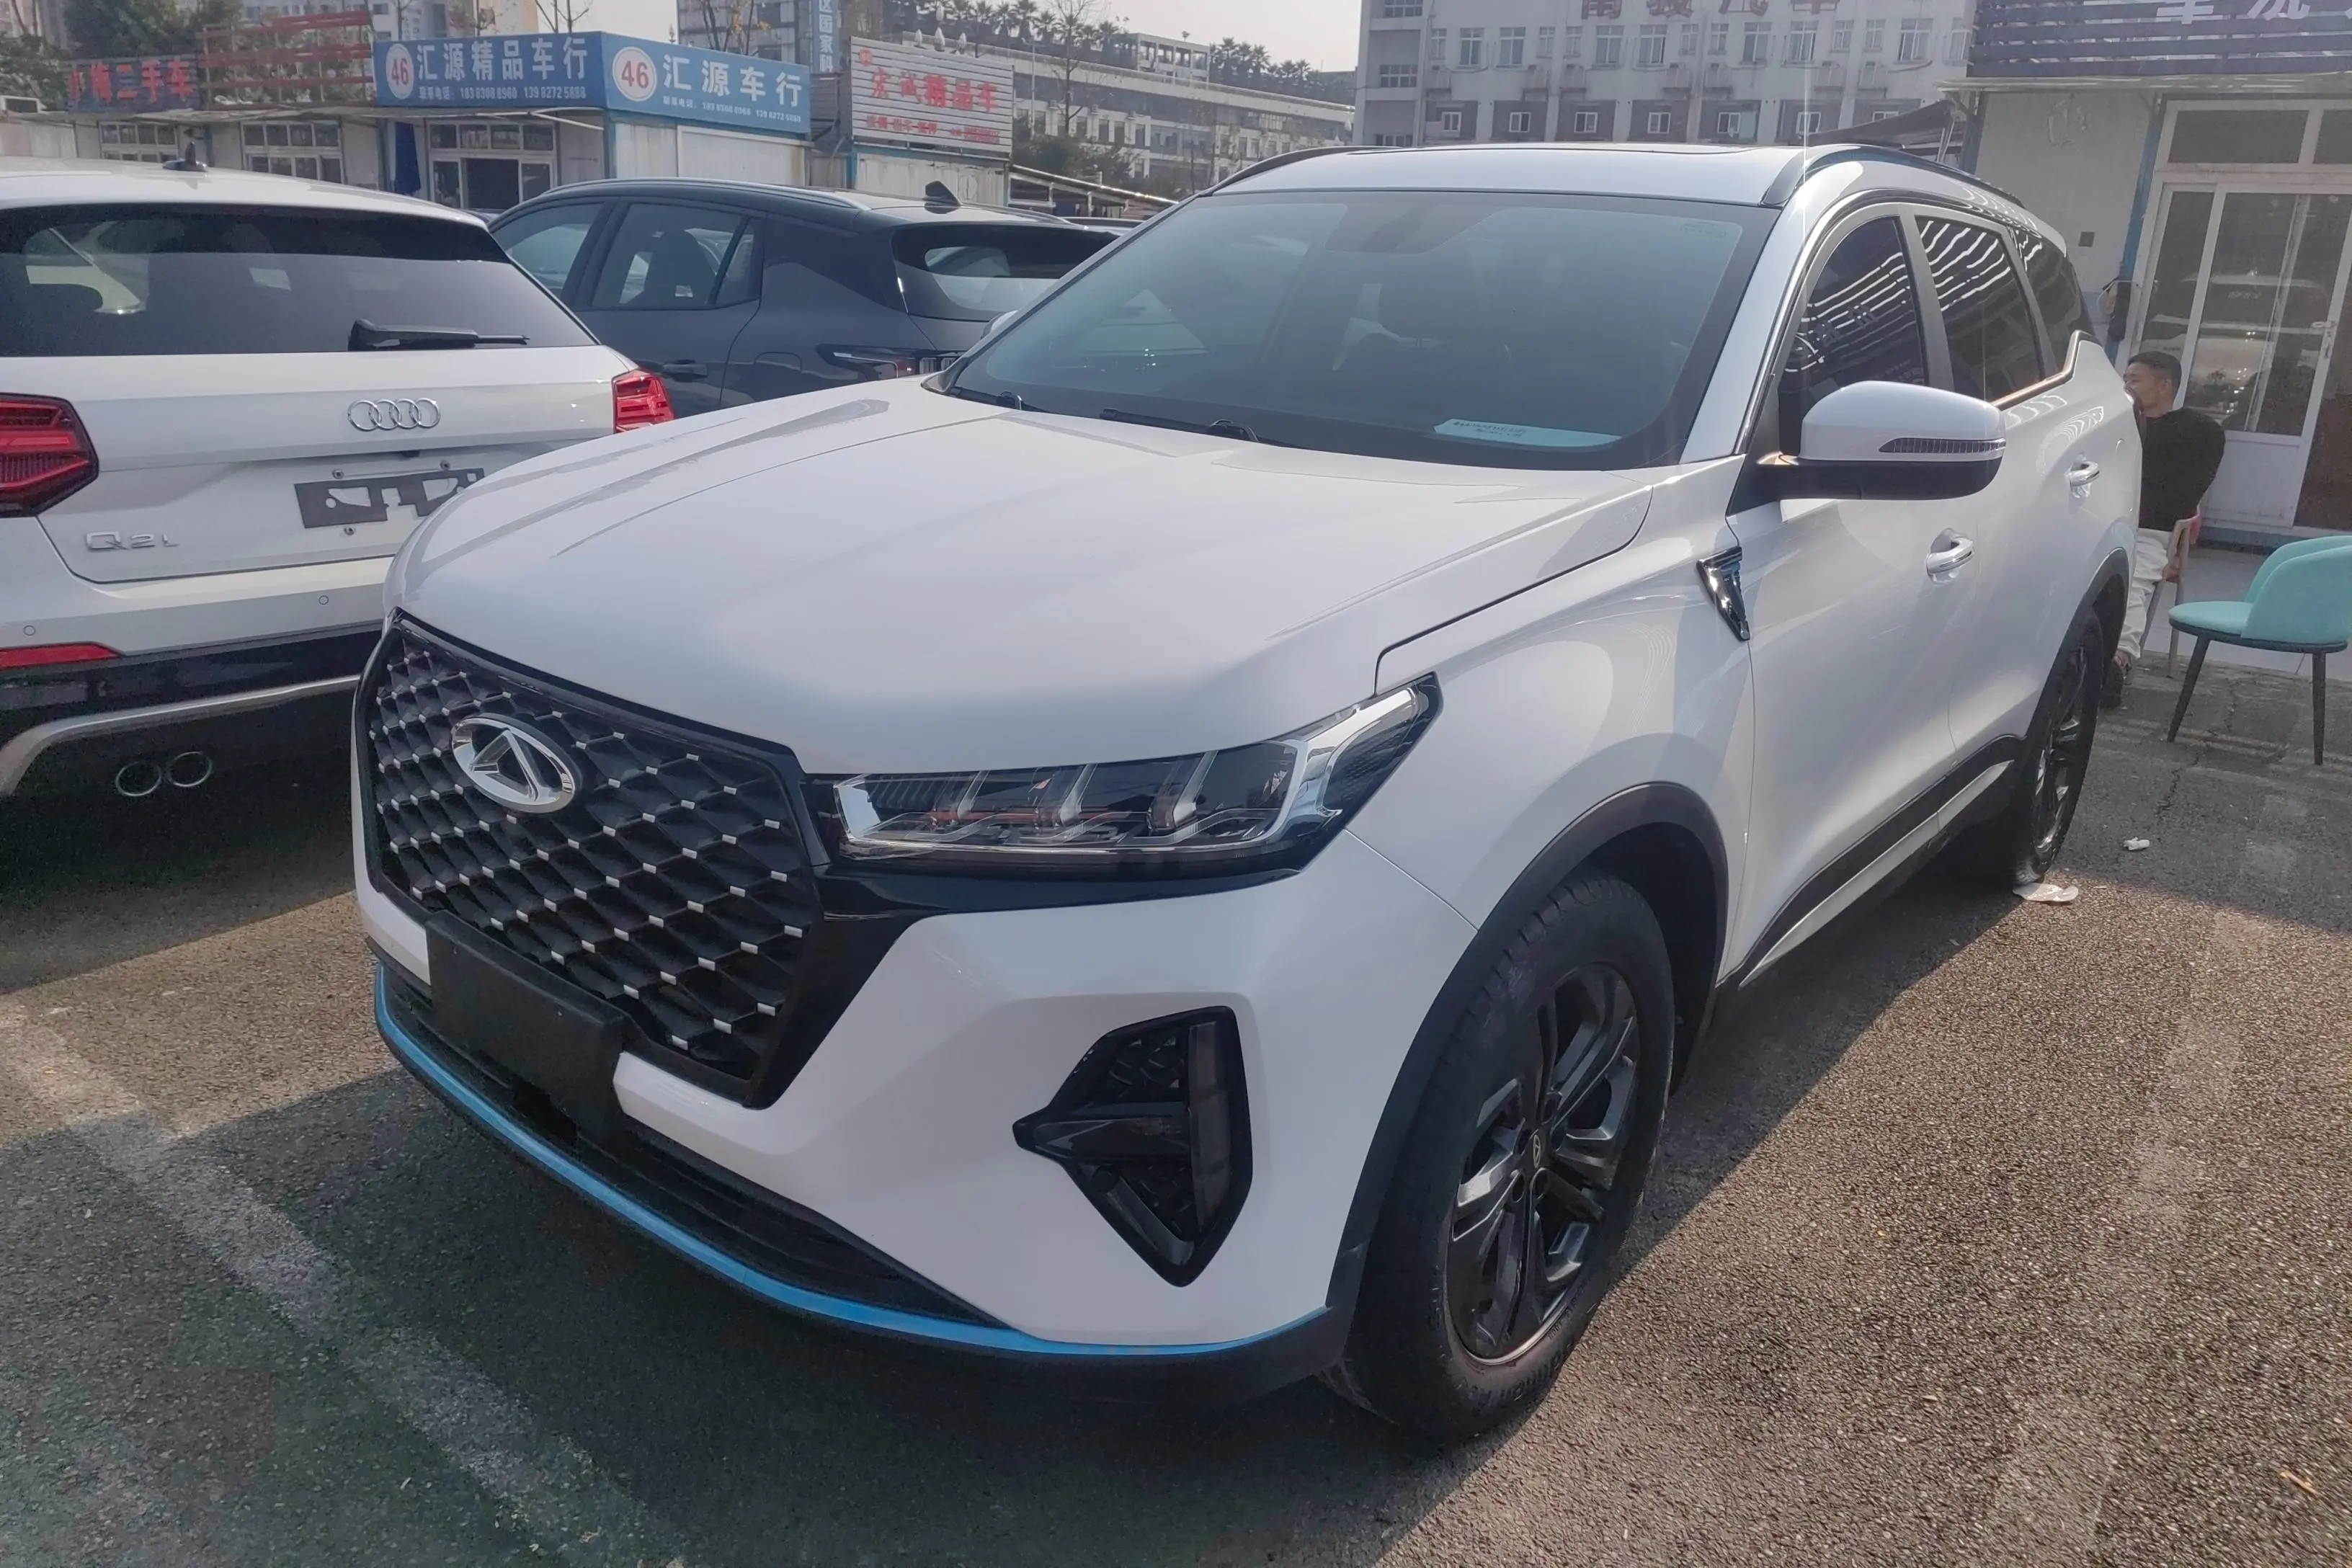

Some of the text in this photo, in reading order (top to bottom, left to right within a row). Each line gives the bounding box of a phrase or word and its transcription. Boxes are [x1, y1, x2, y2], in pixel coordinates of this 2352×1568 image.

[391, 57, 409, 87] 46
[416, 37, 587, 81] 汇源精品车行
[620, 60, 649, 89] 46
[662, 54, 802, 107] 汇源车行
[86, 531, 180, 551] Q2L
